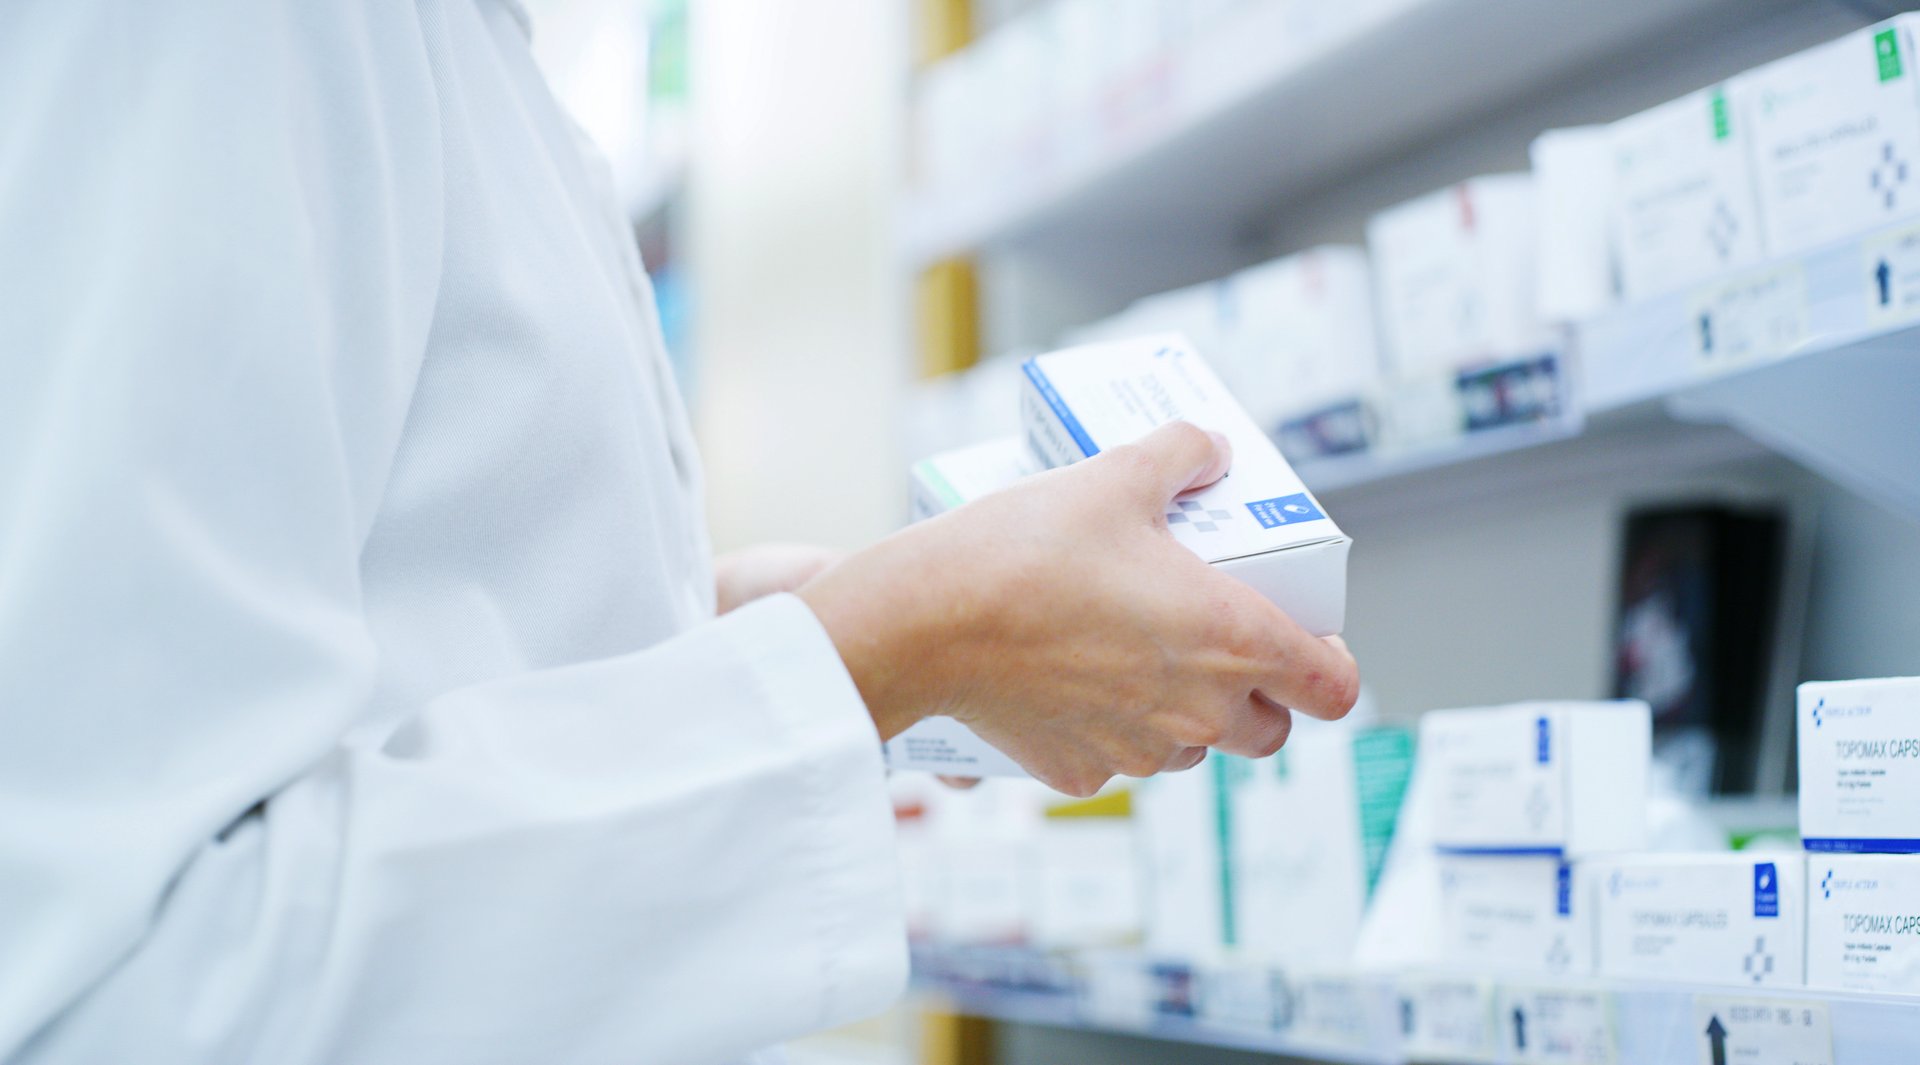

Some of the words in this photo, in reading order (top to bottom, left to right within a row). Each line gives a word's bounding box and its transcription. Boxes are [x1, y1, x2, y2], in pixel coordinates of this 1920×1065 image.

[1836, 739, 1887, 760] TOPOMAX
[1890, 738, 1920, 759] CAPS
[1843, 914, 1893, 934] TOPOMAX
